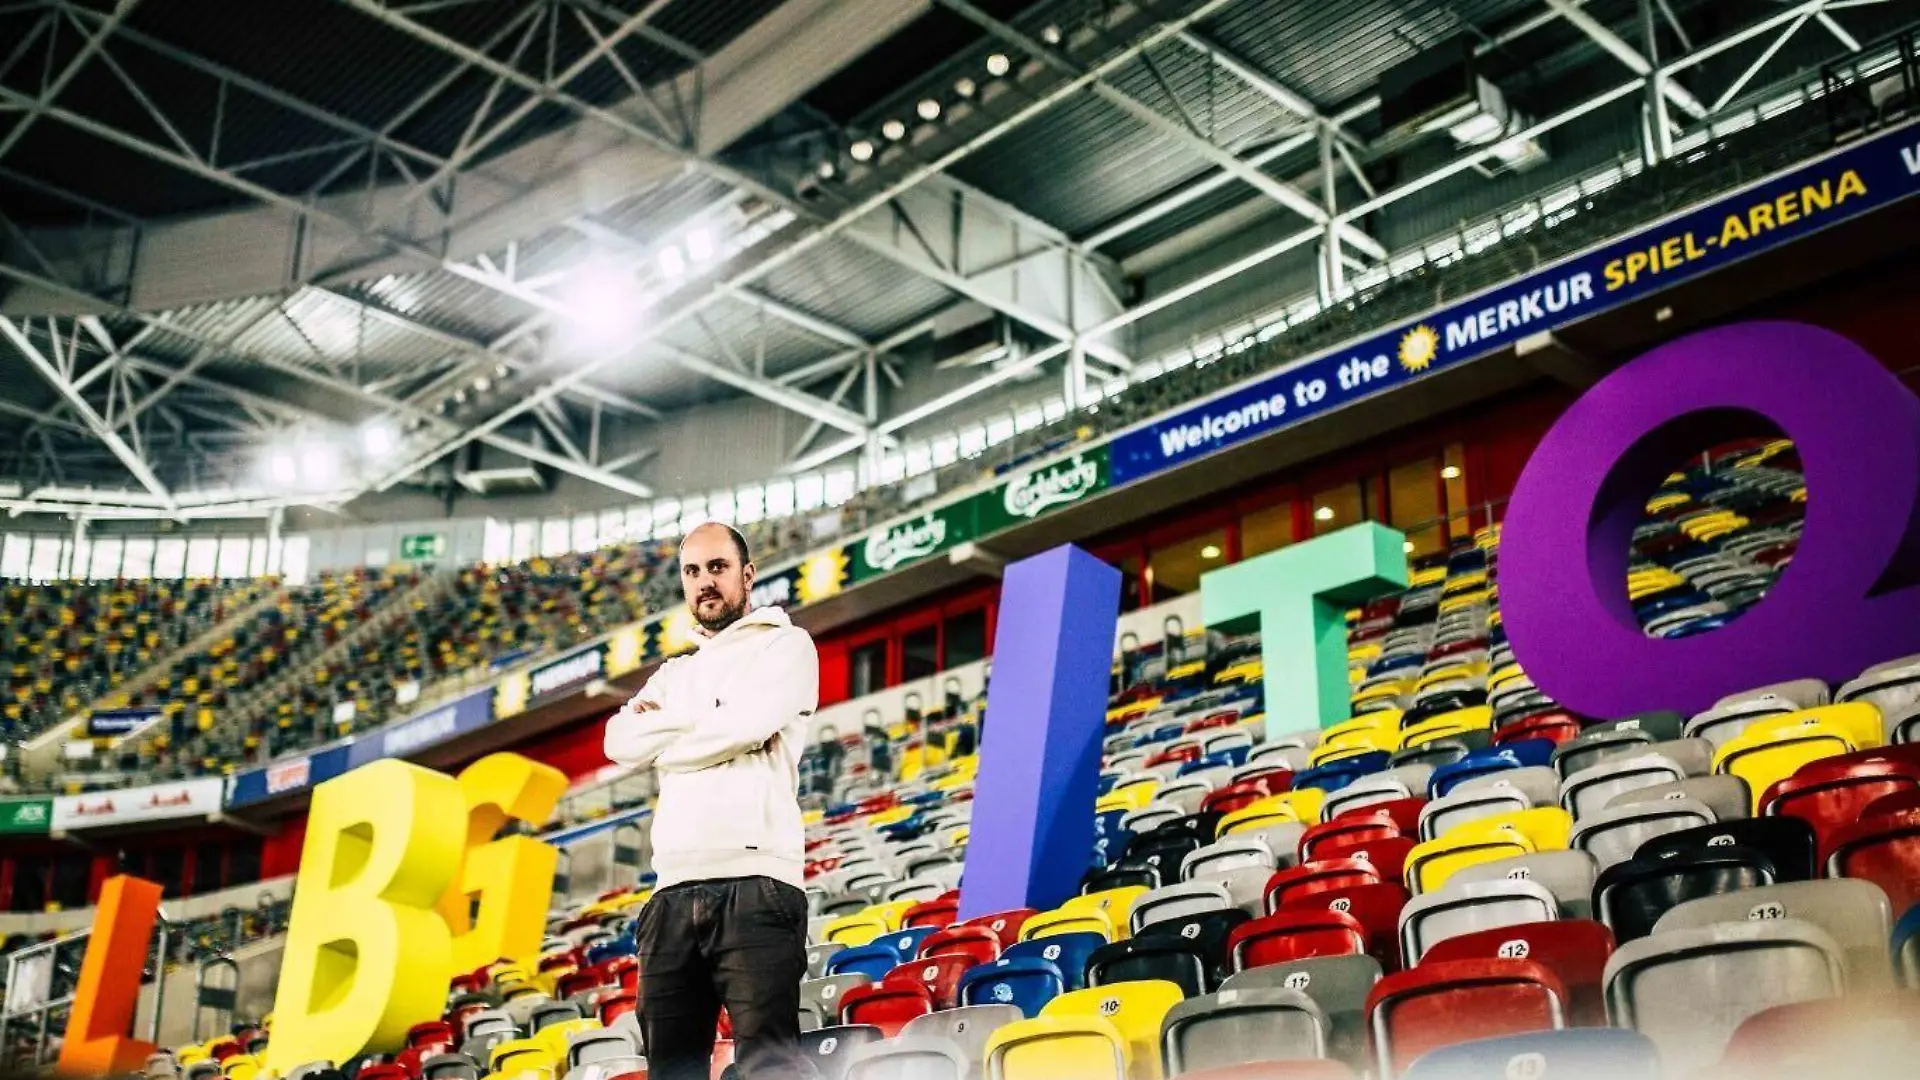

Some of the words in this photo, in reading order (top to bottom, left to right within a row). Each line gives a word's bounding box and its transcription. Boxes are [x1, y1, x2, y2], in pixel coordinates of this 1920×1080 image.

[1160, 393, 1286, 457] Welcome
[1294, 377, 1327, 408] to
[1337, 354, 1391, 391] the
[1444, 271, 1595, 352] MERKUR
[1602, 169, 1868, 292] SPIEL-ARENA
[864, 511, 947, 571] Carlsberg
[1003, 453, 1098, 518] Carlsberg
[1201, 521, 1409, 738] T
[57, 874, 164, 1077] L
[265, 758, 470, 1077] B
